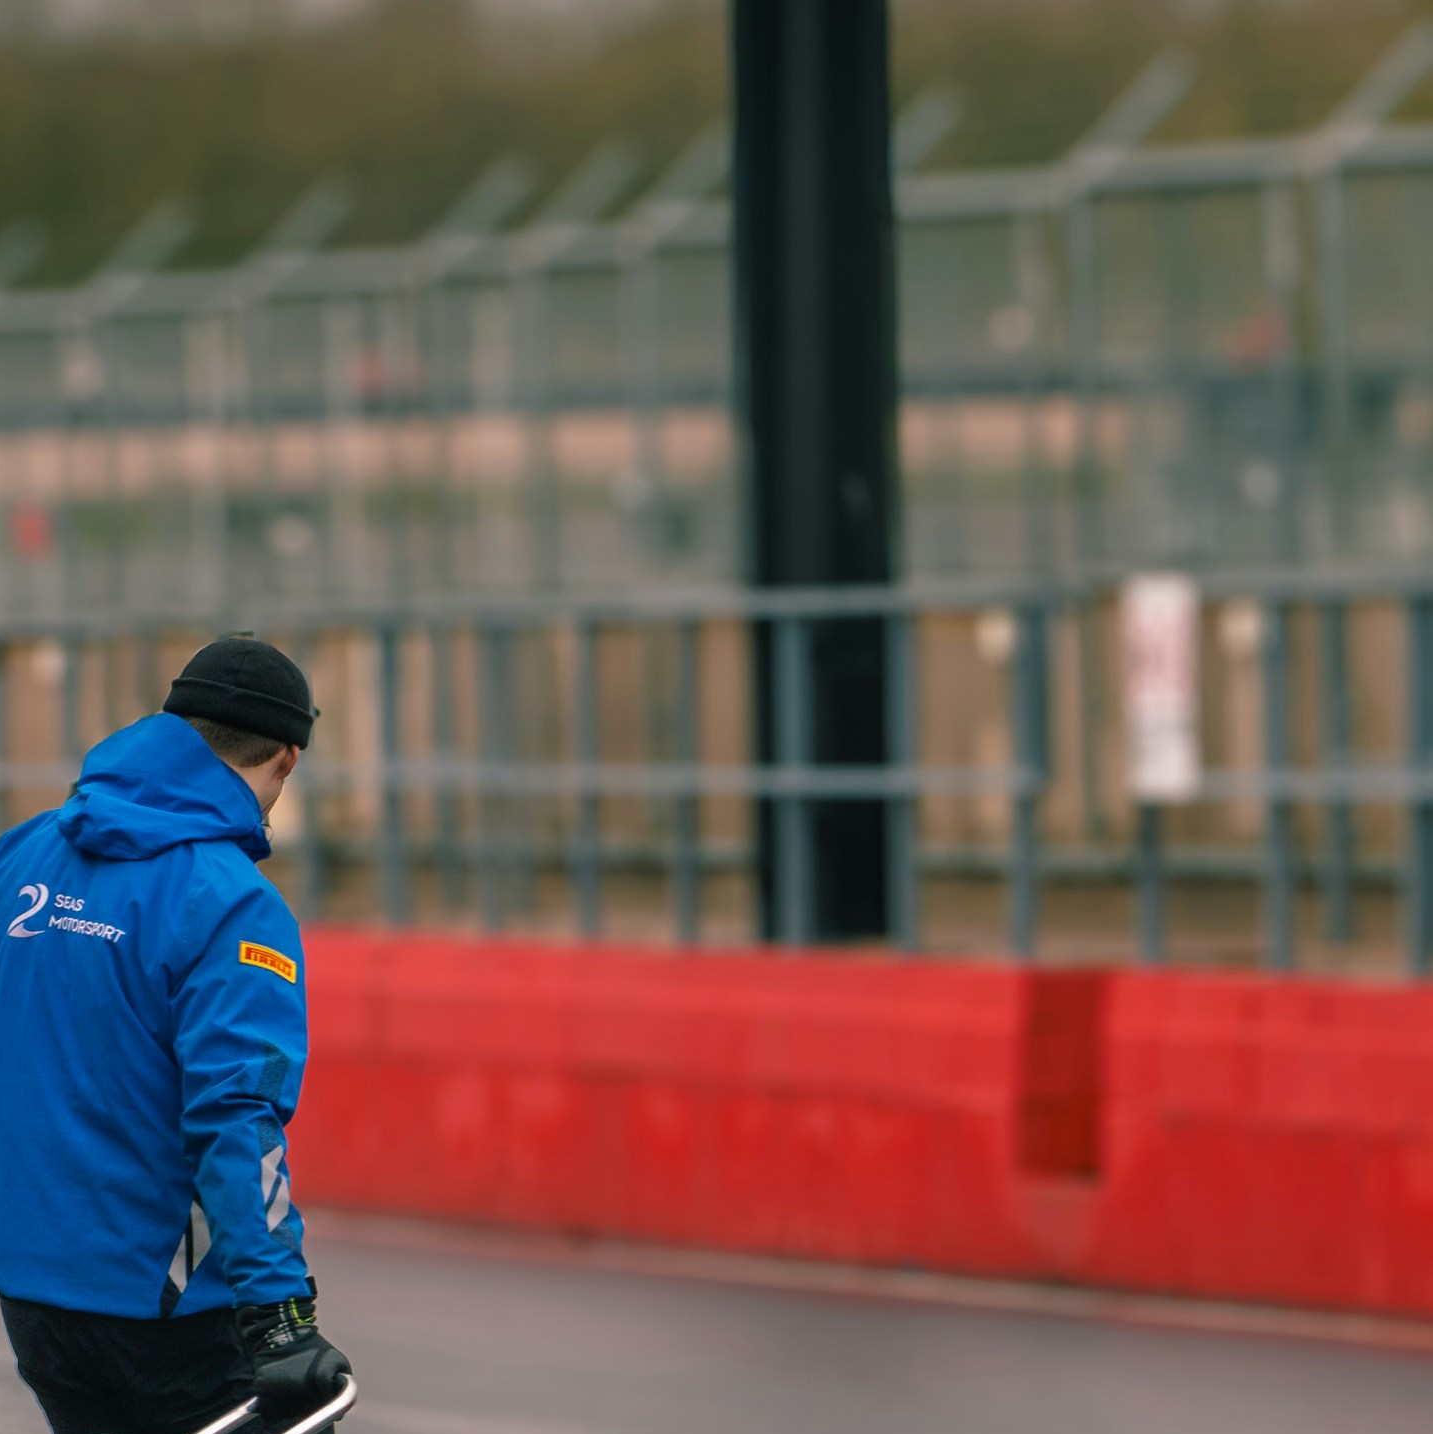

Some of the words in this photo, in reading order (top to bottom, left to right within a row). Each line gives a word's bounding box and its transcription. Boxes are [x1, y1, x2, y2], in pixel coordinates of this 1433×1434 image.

[54, 894, 85, 911] SEAS
[48, 915, 126, 942] MOTORSPORT
[245, 947, 292, 977] PIRELLI
